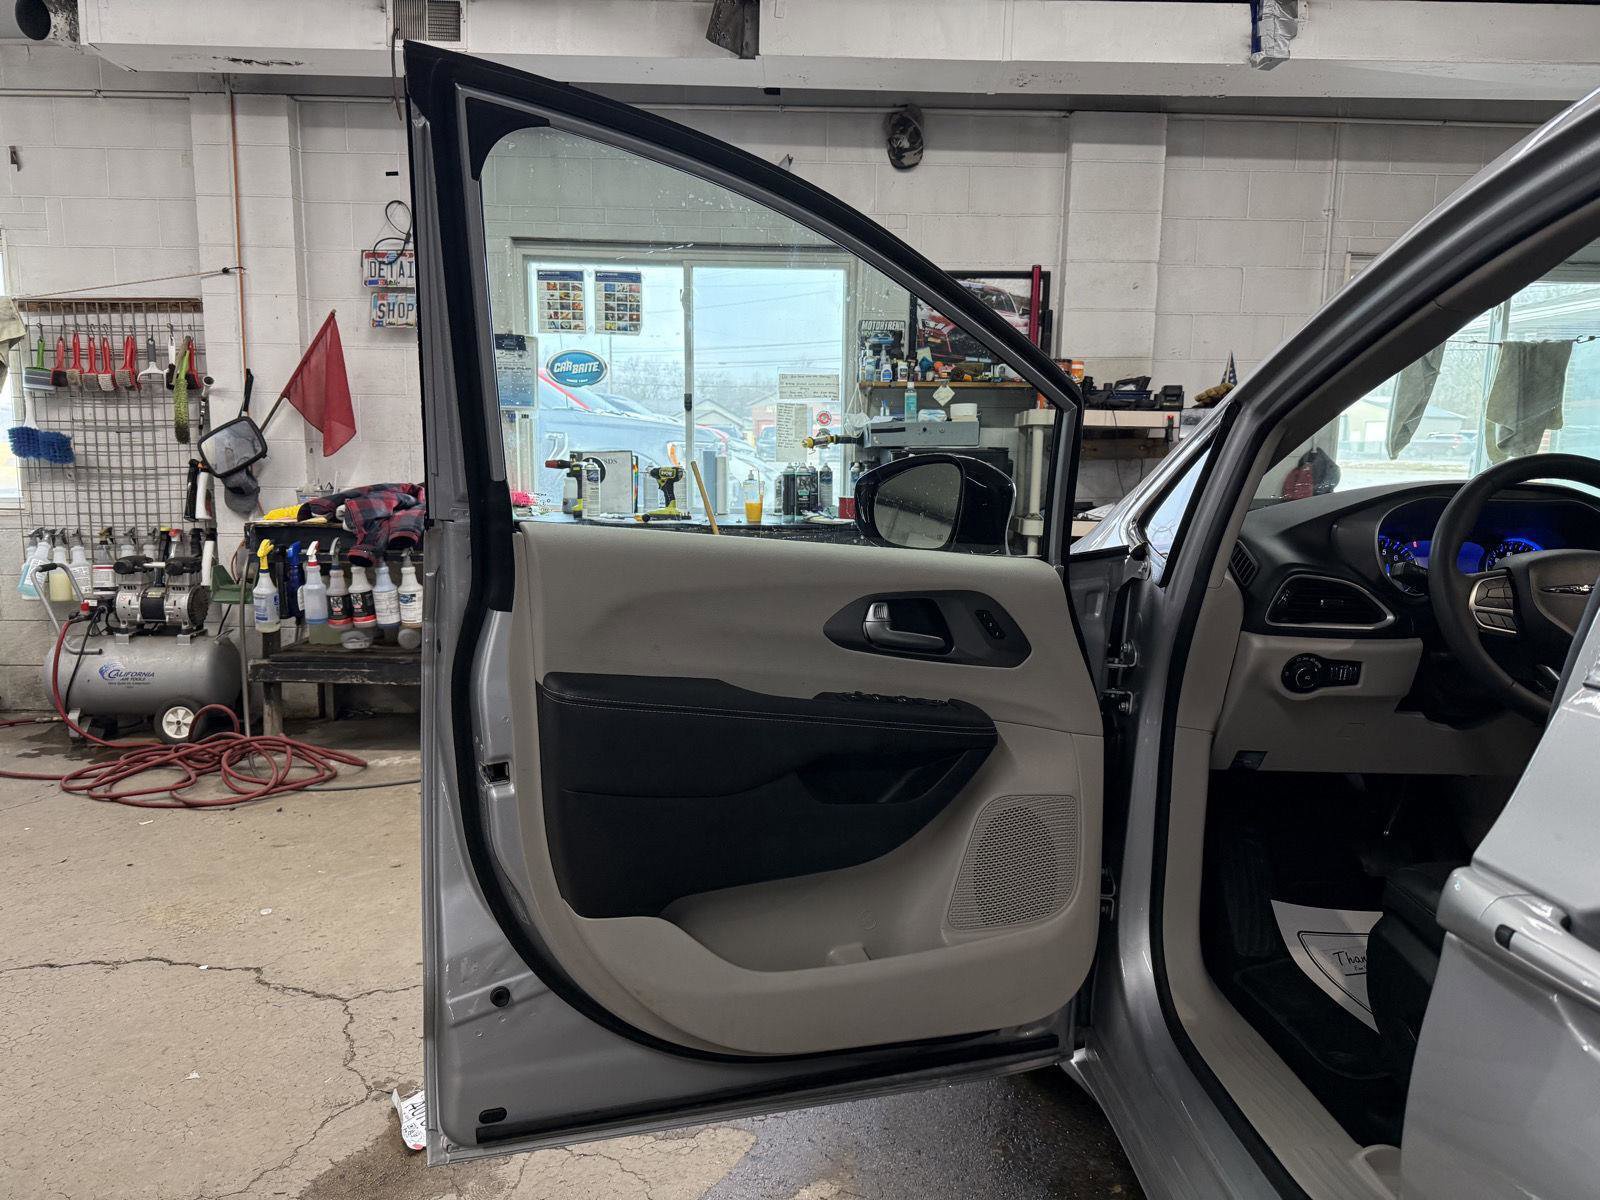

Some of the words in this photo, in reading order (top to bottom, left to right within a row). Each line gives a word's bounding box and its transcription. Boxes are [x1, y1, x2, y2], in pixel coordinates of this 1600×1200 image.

[369, 261, 414, 278] DETAI
[377, 302, 415, 319] SHOP
[109, 669, 155, 678] CALIFORNIA
[1332, 950, 1367, 966] Than
